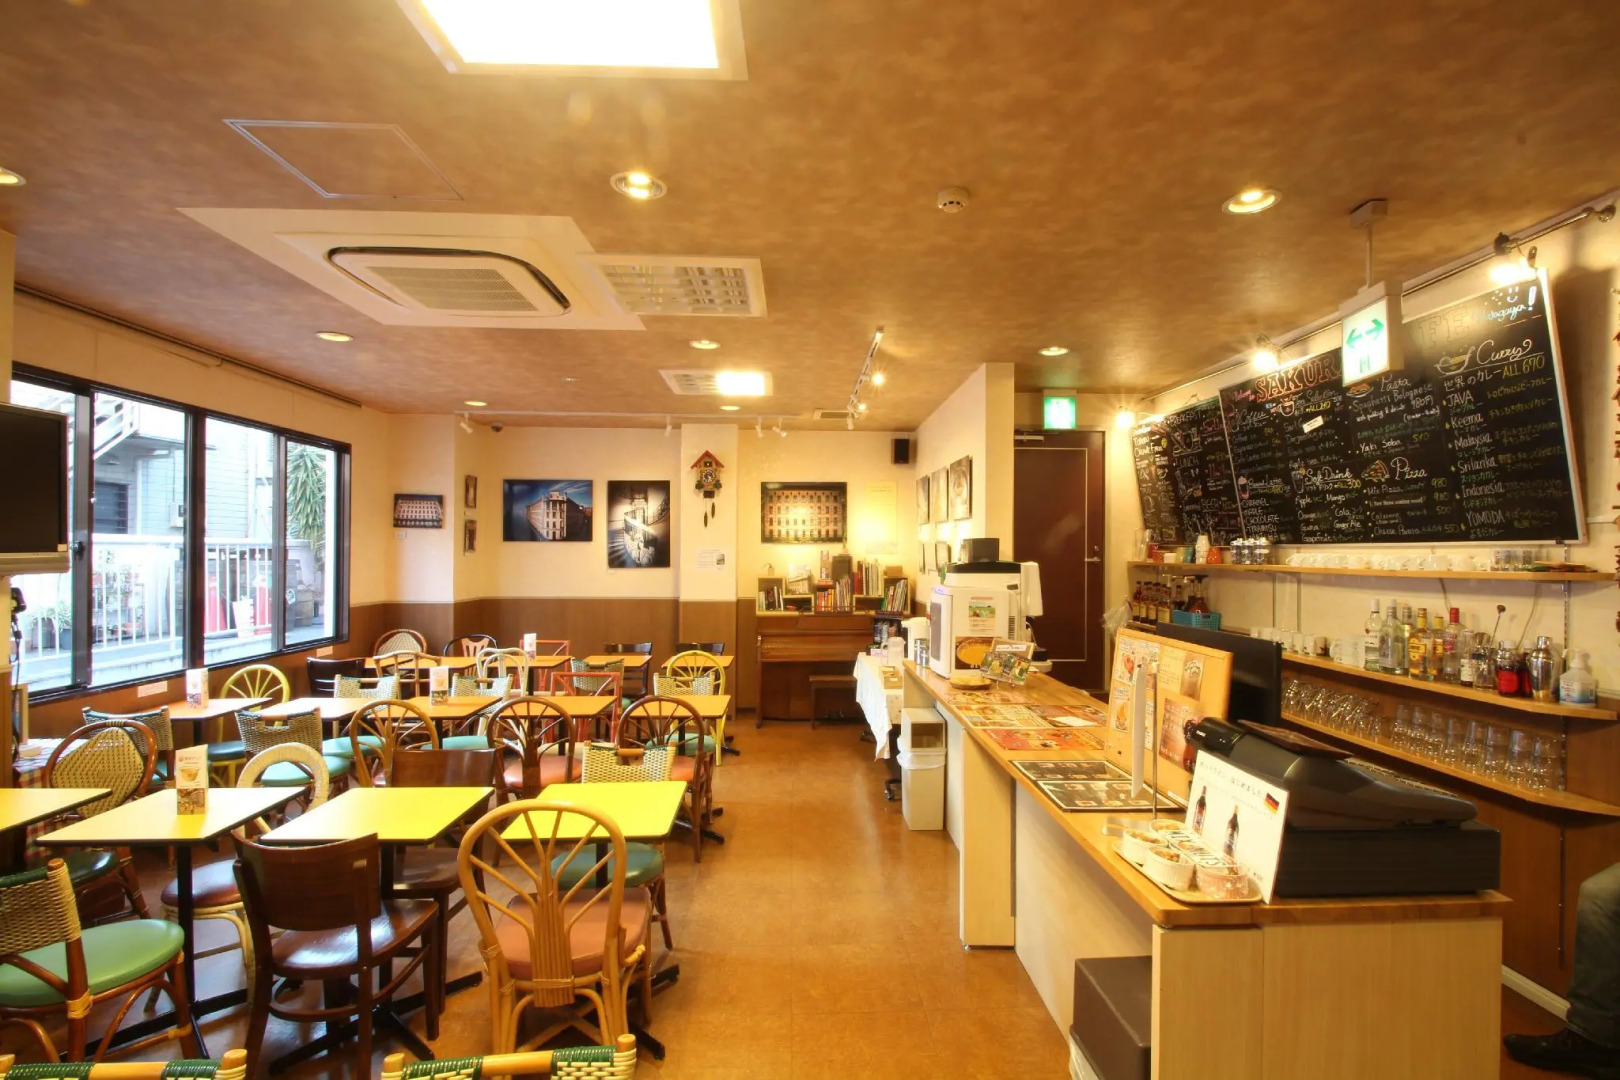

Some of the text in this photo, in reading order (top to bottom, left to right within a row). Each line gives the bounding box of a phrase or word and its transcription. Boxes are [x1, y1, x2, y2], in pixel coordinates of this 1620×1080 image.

[1477, 339, 1532, 365] Curry
[1255, 353, 1342, 403] SAKUR
[1380, 373, 1411, 392] Pasta
[1444, 355, 1545, 392] 世界のカレー ALL 670
[1447, 390, 1474, 408] JAVA
[1451, 413, 1483, 429] Keema
[1360, 442, 1377, 453] Yaki
[1454, 432, 1493, 450] Malaysia
[1322, 466, 1353, 480] Drink
[1390, 456, 1428, 480] Pizza
[1462, 480, 1506, 498] Indonesia
[1465, 510, 1505, 527] YOMODA
